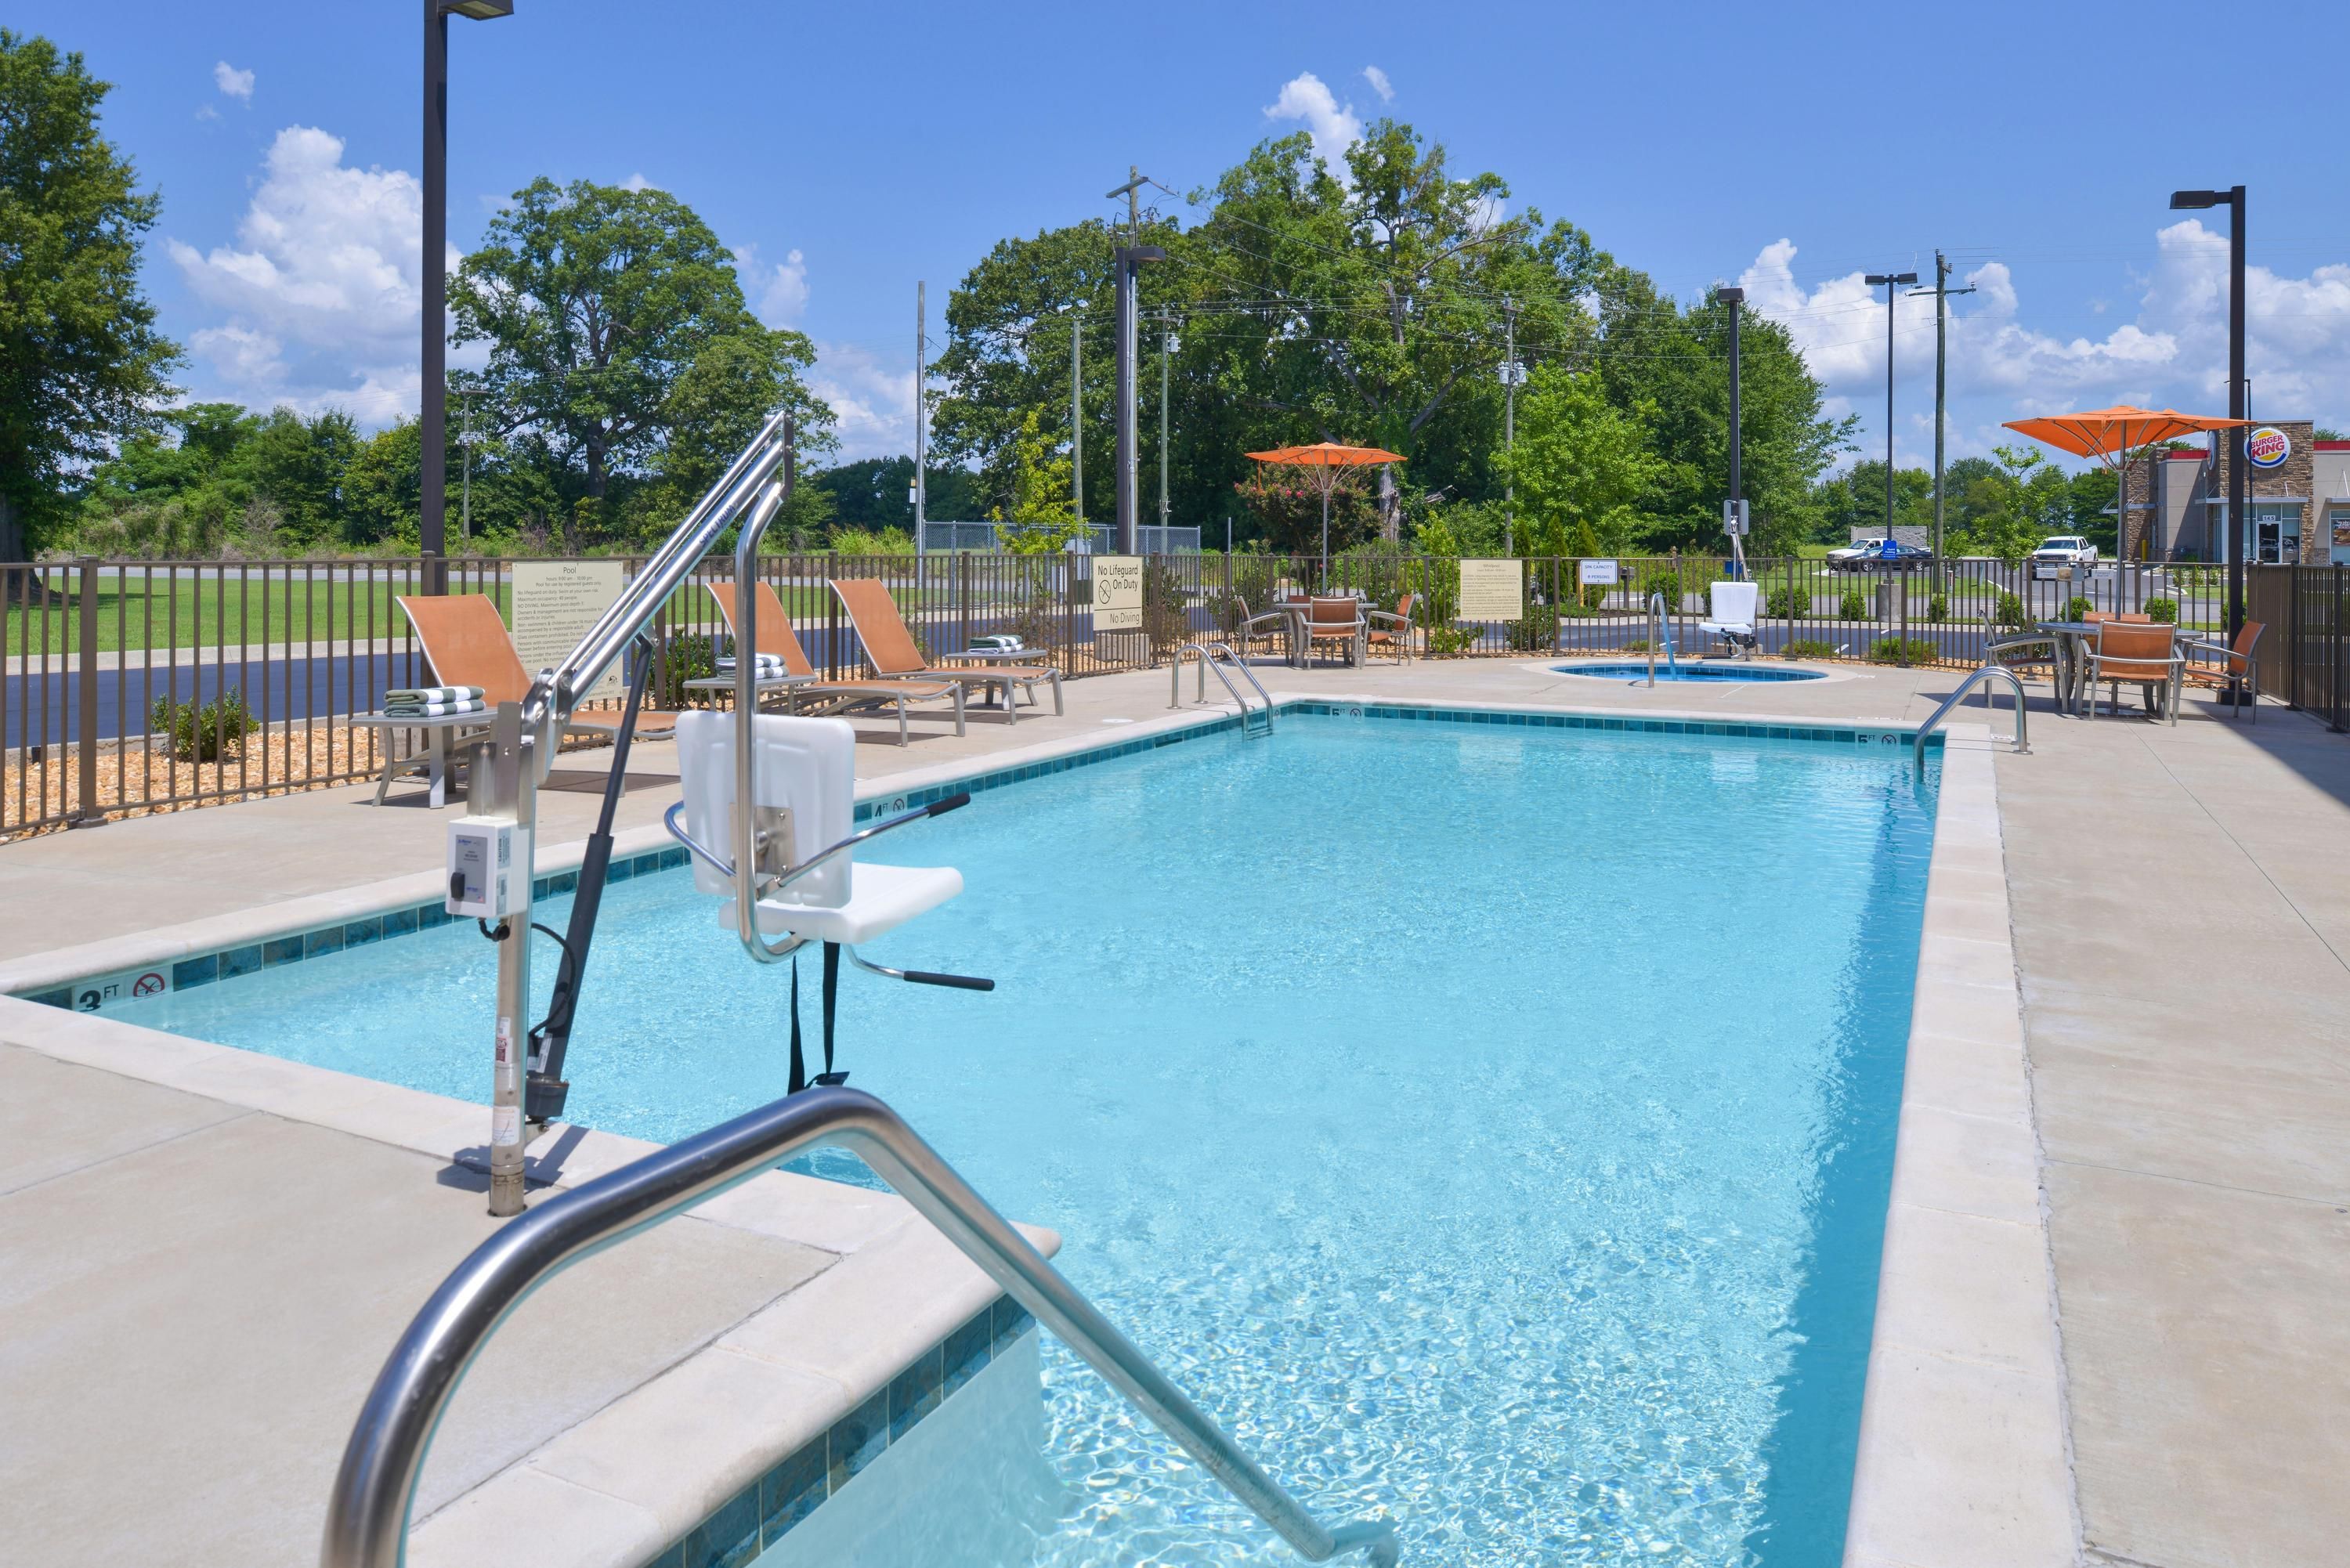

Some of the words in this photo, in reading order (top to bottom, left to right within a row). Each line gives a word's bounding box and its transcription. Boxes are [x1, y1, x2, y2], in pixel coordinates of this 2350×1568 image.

[2251, 435, 2283, 448] BURGER
[2252, 441, 2284, 458] KING
[1098, 565, 1108, 576] No
[1109, 564, 1138, 577] Lifeguard
[1112, 579, 1122, 590] On
[1123, 579, 1138, 591] Duty
[1110, 613, 1119, 623] No
[1120, 612, 1140, 624] Diving
[79, 989, 101, 1013] 3
[104, 984, 119, 999] FT
